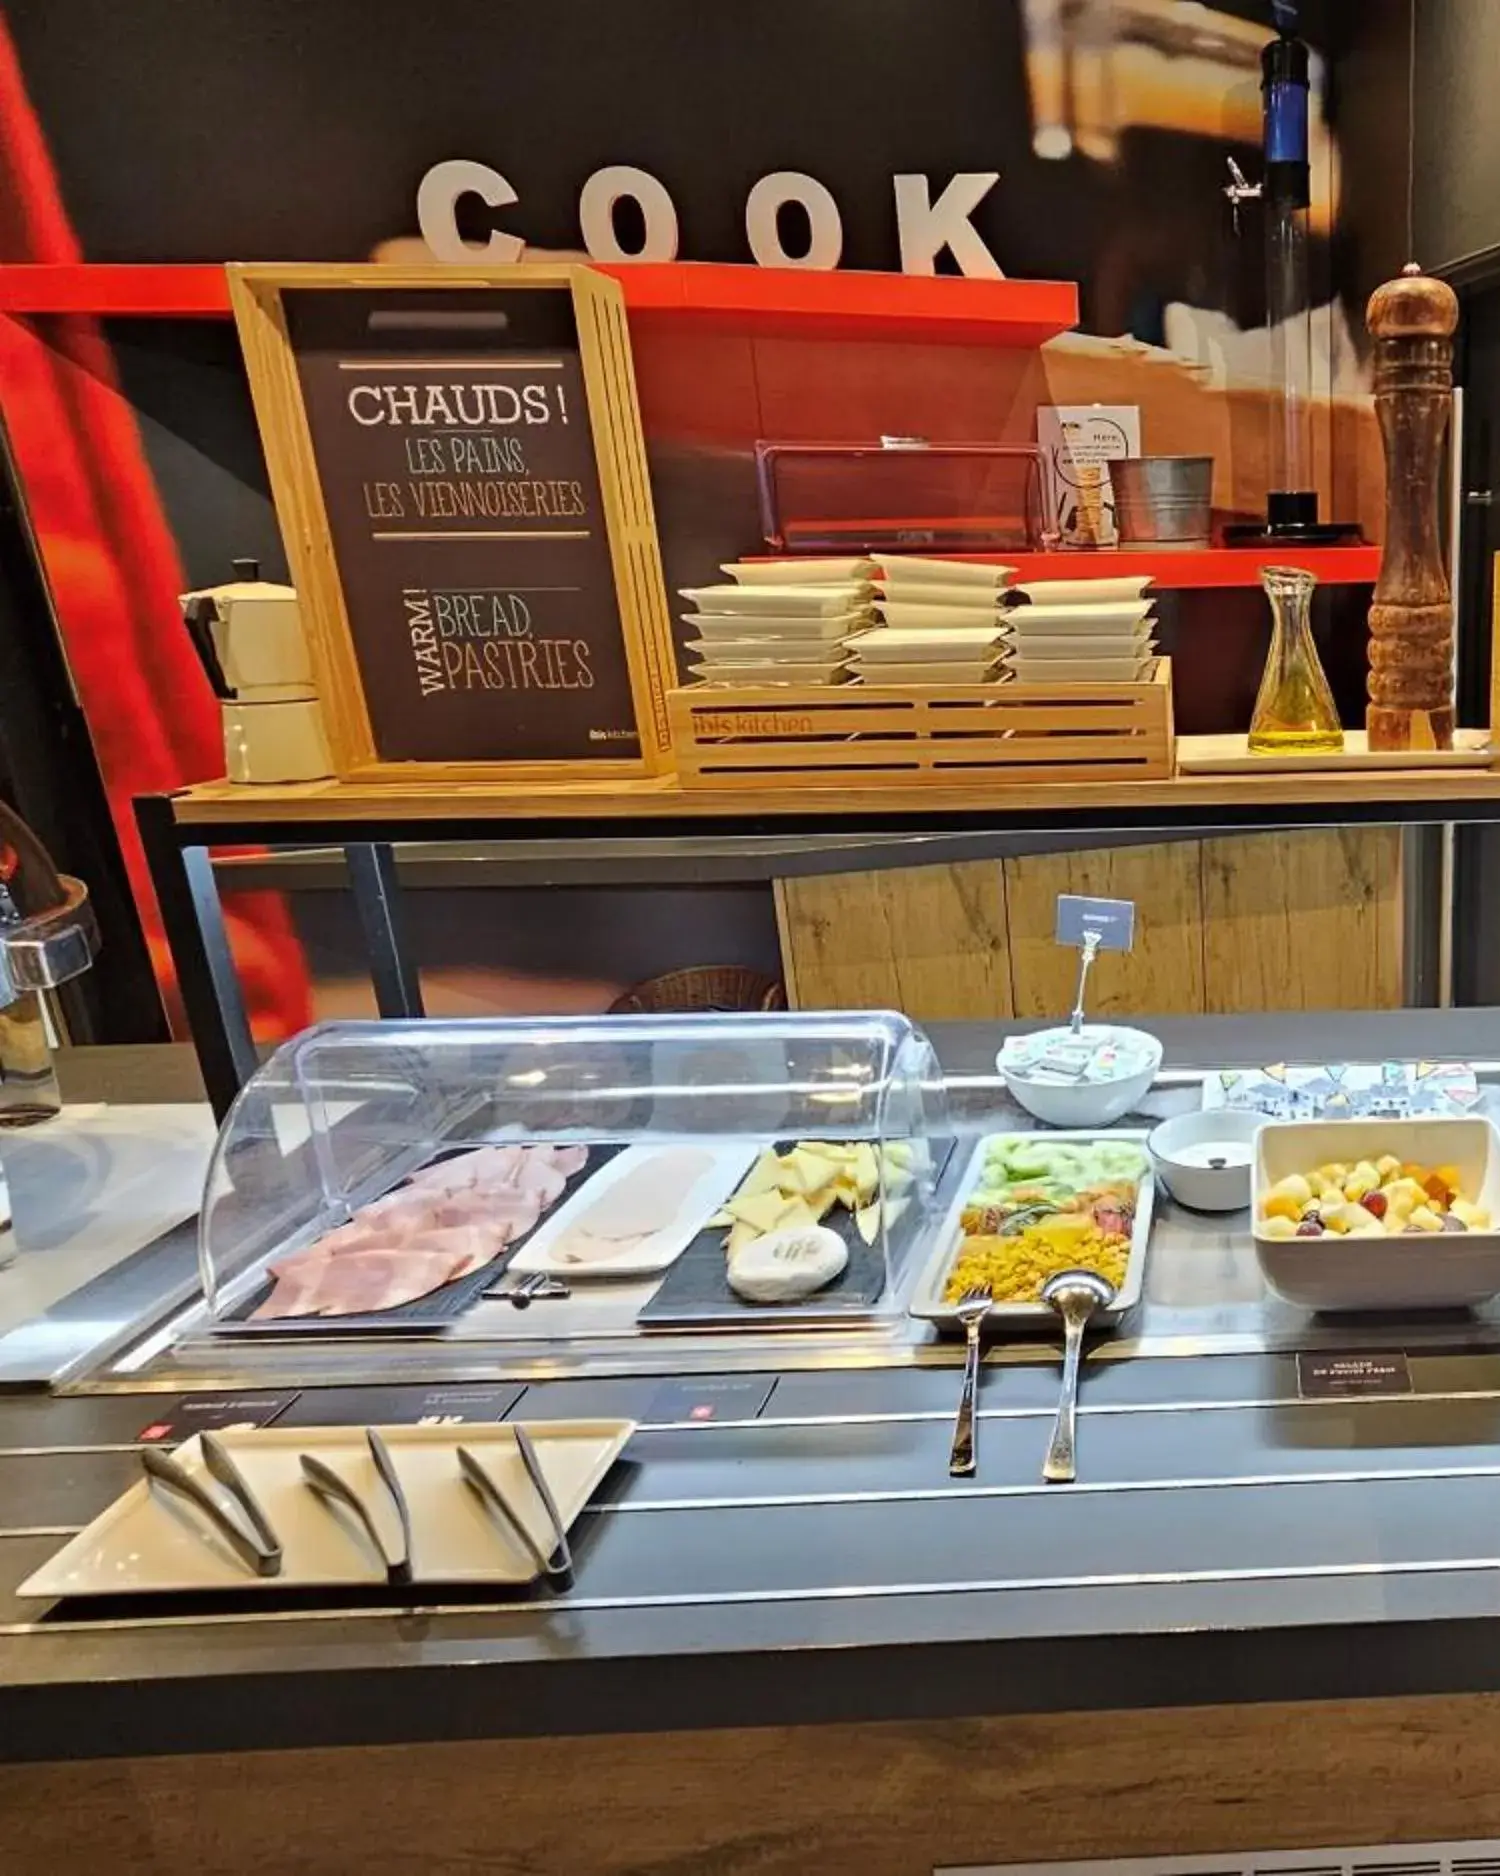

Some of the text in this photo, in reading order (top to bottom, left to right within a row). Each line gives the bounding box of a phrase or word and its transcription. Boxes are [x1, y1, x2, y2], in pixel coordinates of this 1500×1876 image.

[417, 159, 1006, 280] COOK
[405, 437, 530, 476] LES PAINS,
[363, 480, 586, 518] LES VIENNOISERIES
[433, 594, 534, 638] BREAD,
[402, 588, 446, 697] WARM!
[440, 640, 595, 690] PASTRIES
[692, 713, 813, 734] ibis kitchen
